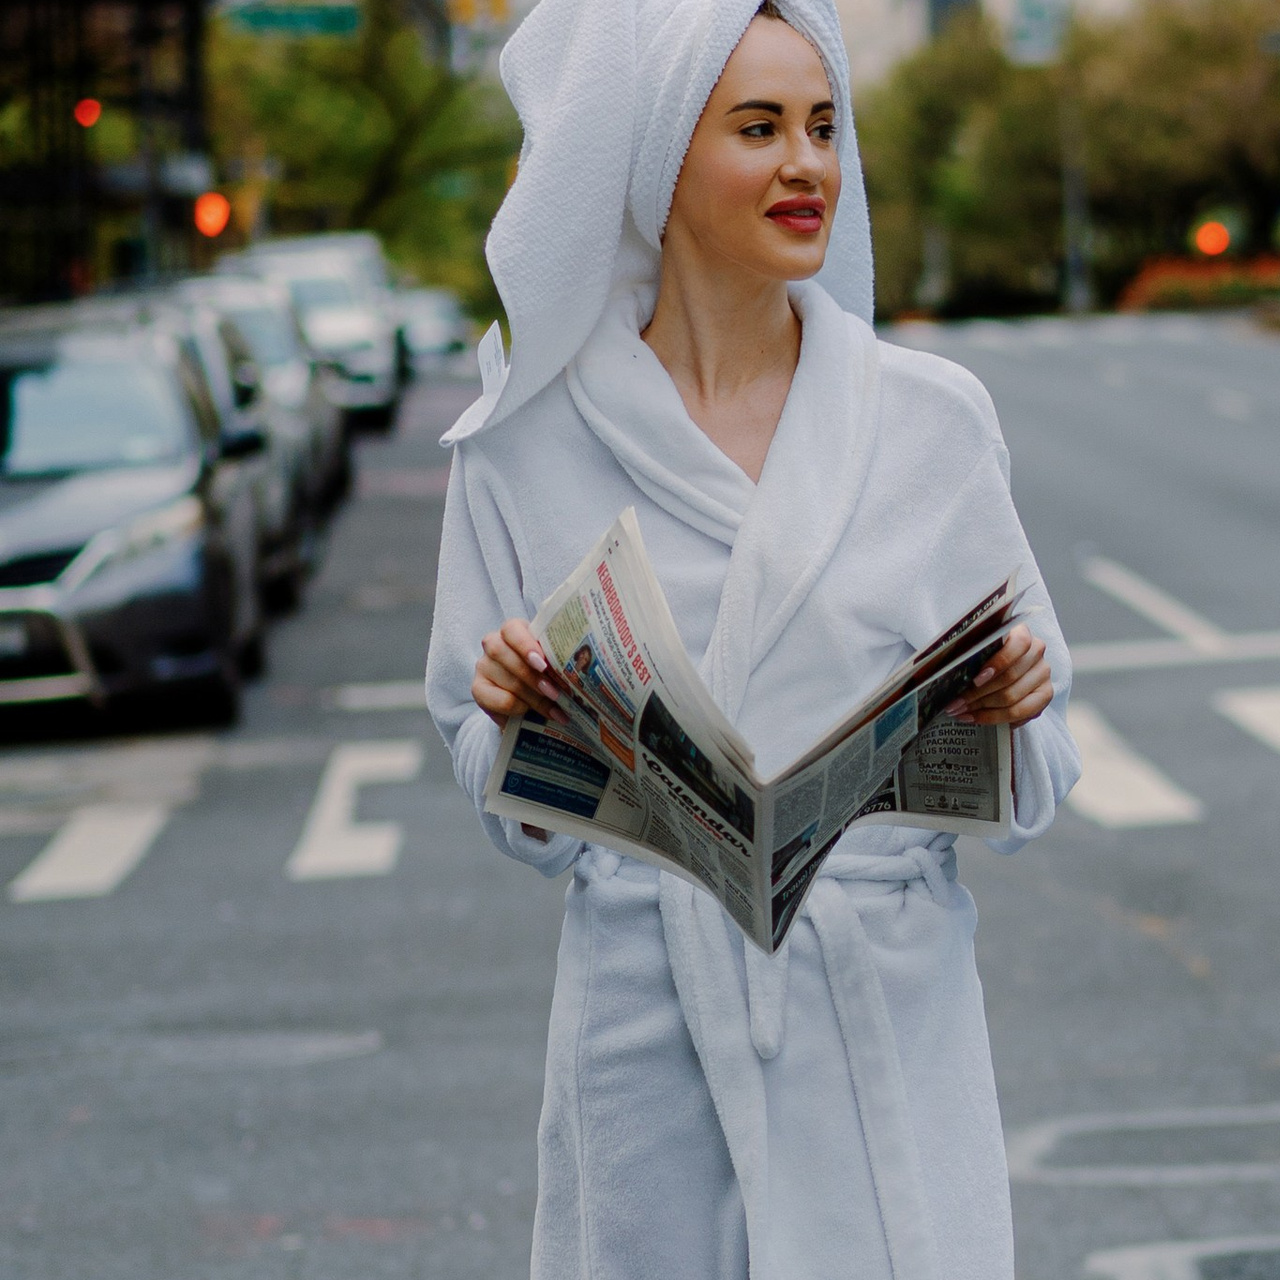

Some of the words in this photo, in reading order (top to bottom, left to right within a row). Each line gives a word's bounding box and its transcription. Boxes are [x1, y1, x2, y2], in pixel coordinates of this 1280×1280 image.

[596, 560, 637, 659] NEIGHBORHOOD'S
[631, 654, 652, 687] BEST
[938, 728, 976, 736] SHOWER
[926, 737, 967, 746] PACKAGE
[522, 740, 548, 756] Physical
[548, 748, 575, 766] Therapy
[914, 747, 937, 756] PLUS
[963, 747, 980, 756] OFF
[919, 762, 943, 771] SAFE
[954, 763, 978, 772] STEP
[642, 752, 751, 858] Calendar
